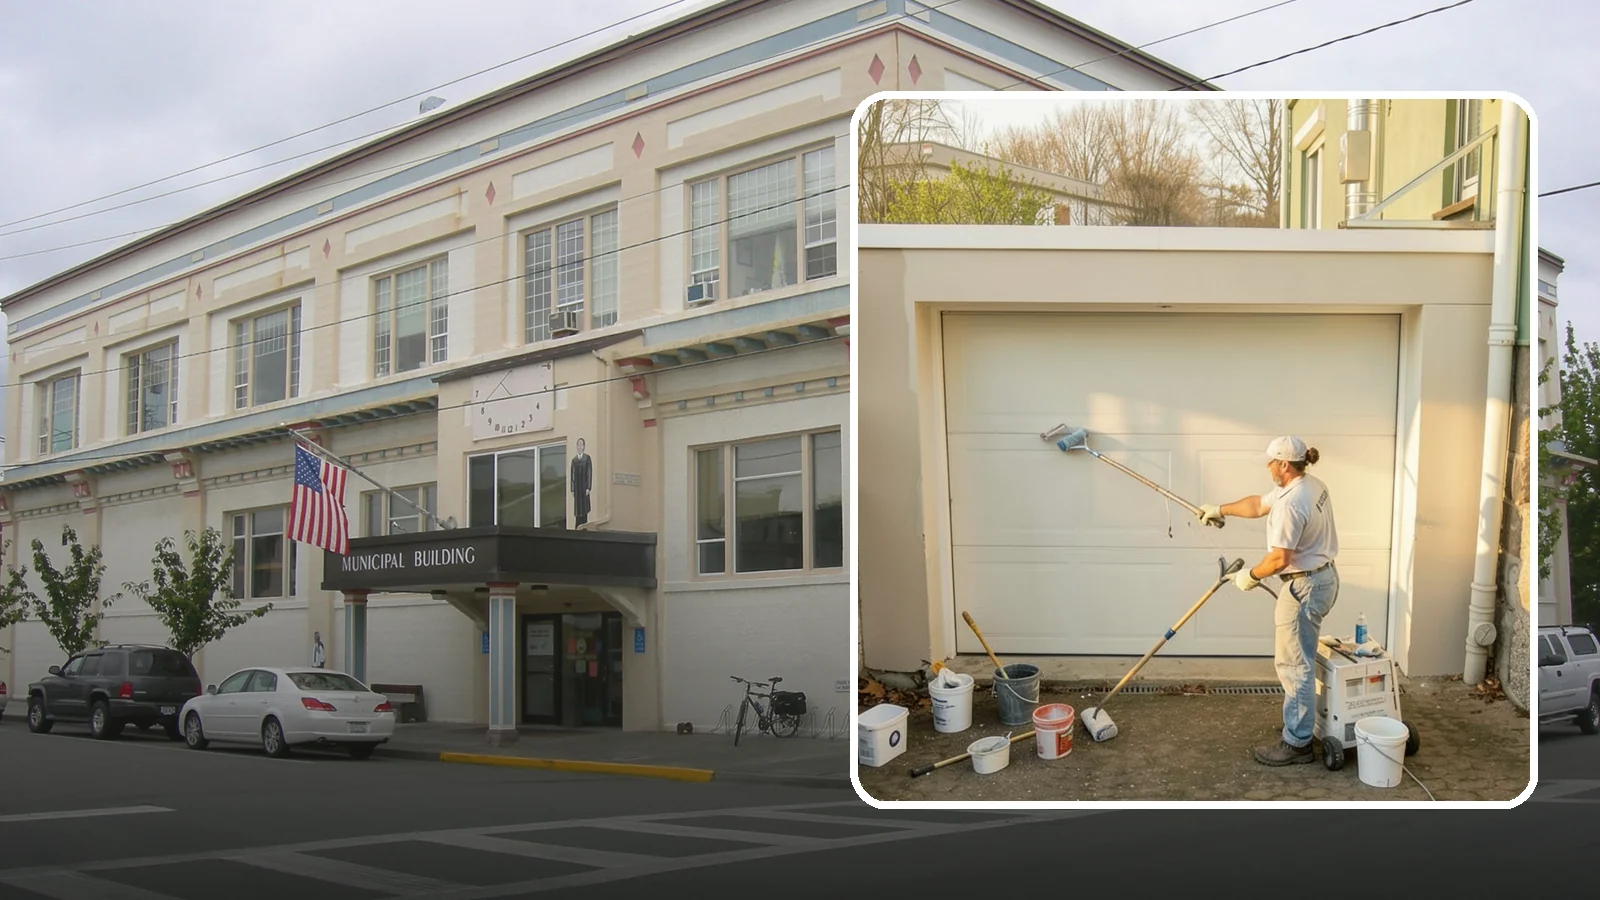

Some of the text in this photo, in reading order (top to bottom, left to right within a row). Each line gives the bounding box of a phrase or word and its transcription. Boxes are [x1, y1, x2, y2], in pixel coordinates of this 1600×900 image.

[547, 362, 551, 370] 6
[475, 390, 479, 398] 7
[536, 402, 540, 410] 4
[481, 407, 485, 415] 8
[488, 417, 492, 426] 9
[529, 414, 533, 422] 3
[521, 420, 525, 428] 2
[508, 425, 513, 433] 12
[342, 546, 475, 572] MUNICIPAL BUILDING
